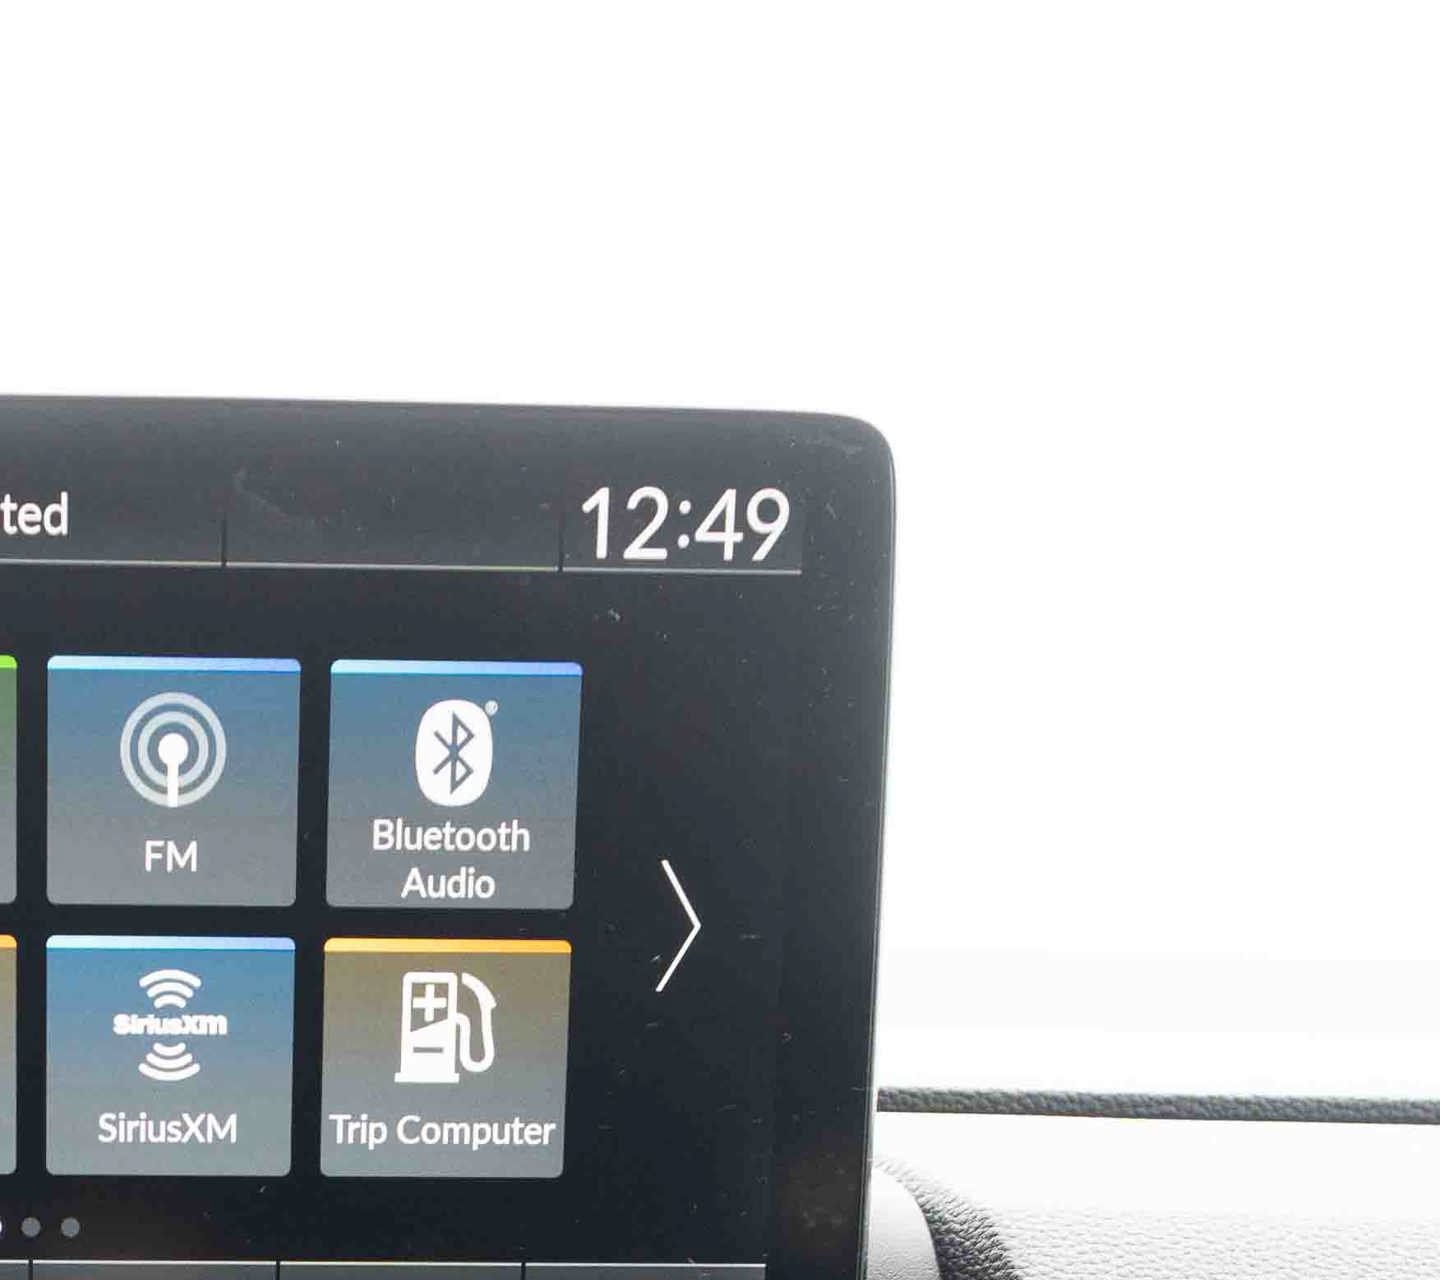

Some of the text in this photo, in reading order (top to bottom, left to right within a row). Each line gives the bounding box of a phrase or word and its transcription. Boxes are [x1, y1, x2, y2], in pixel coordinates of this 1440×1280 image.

[581, 486, 790, 562] 12:49
[372, 817, 531, 852] Bluetooth
[144, 840, 198, 873] FM
[400, 866, 496, 899] Audio
[98, 1111, 238, 1144] SiriusXM
[328, 1113, 557, 1151] Trip Computer
